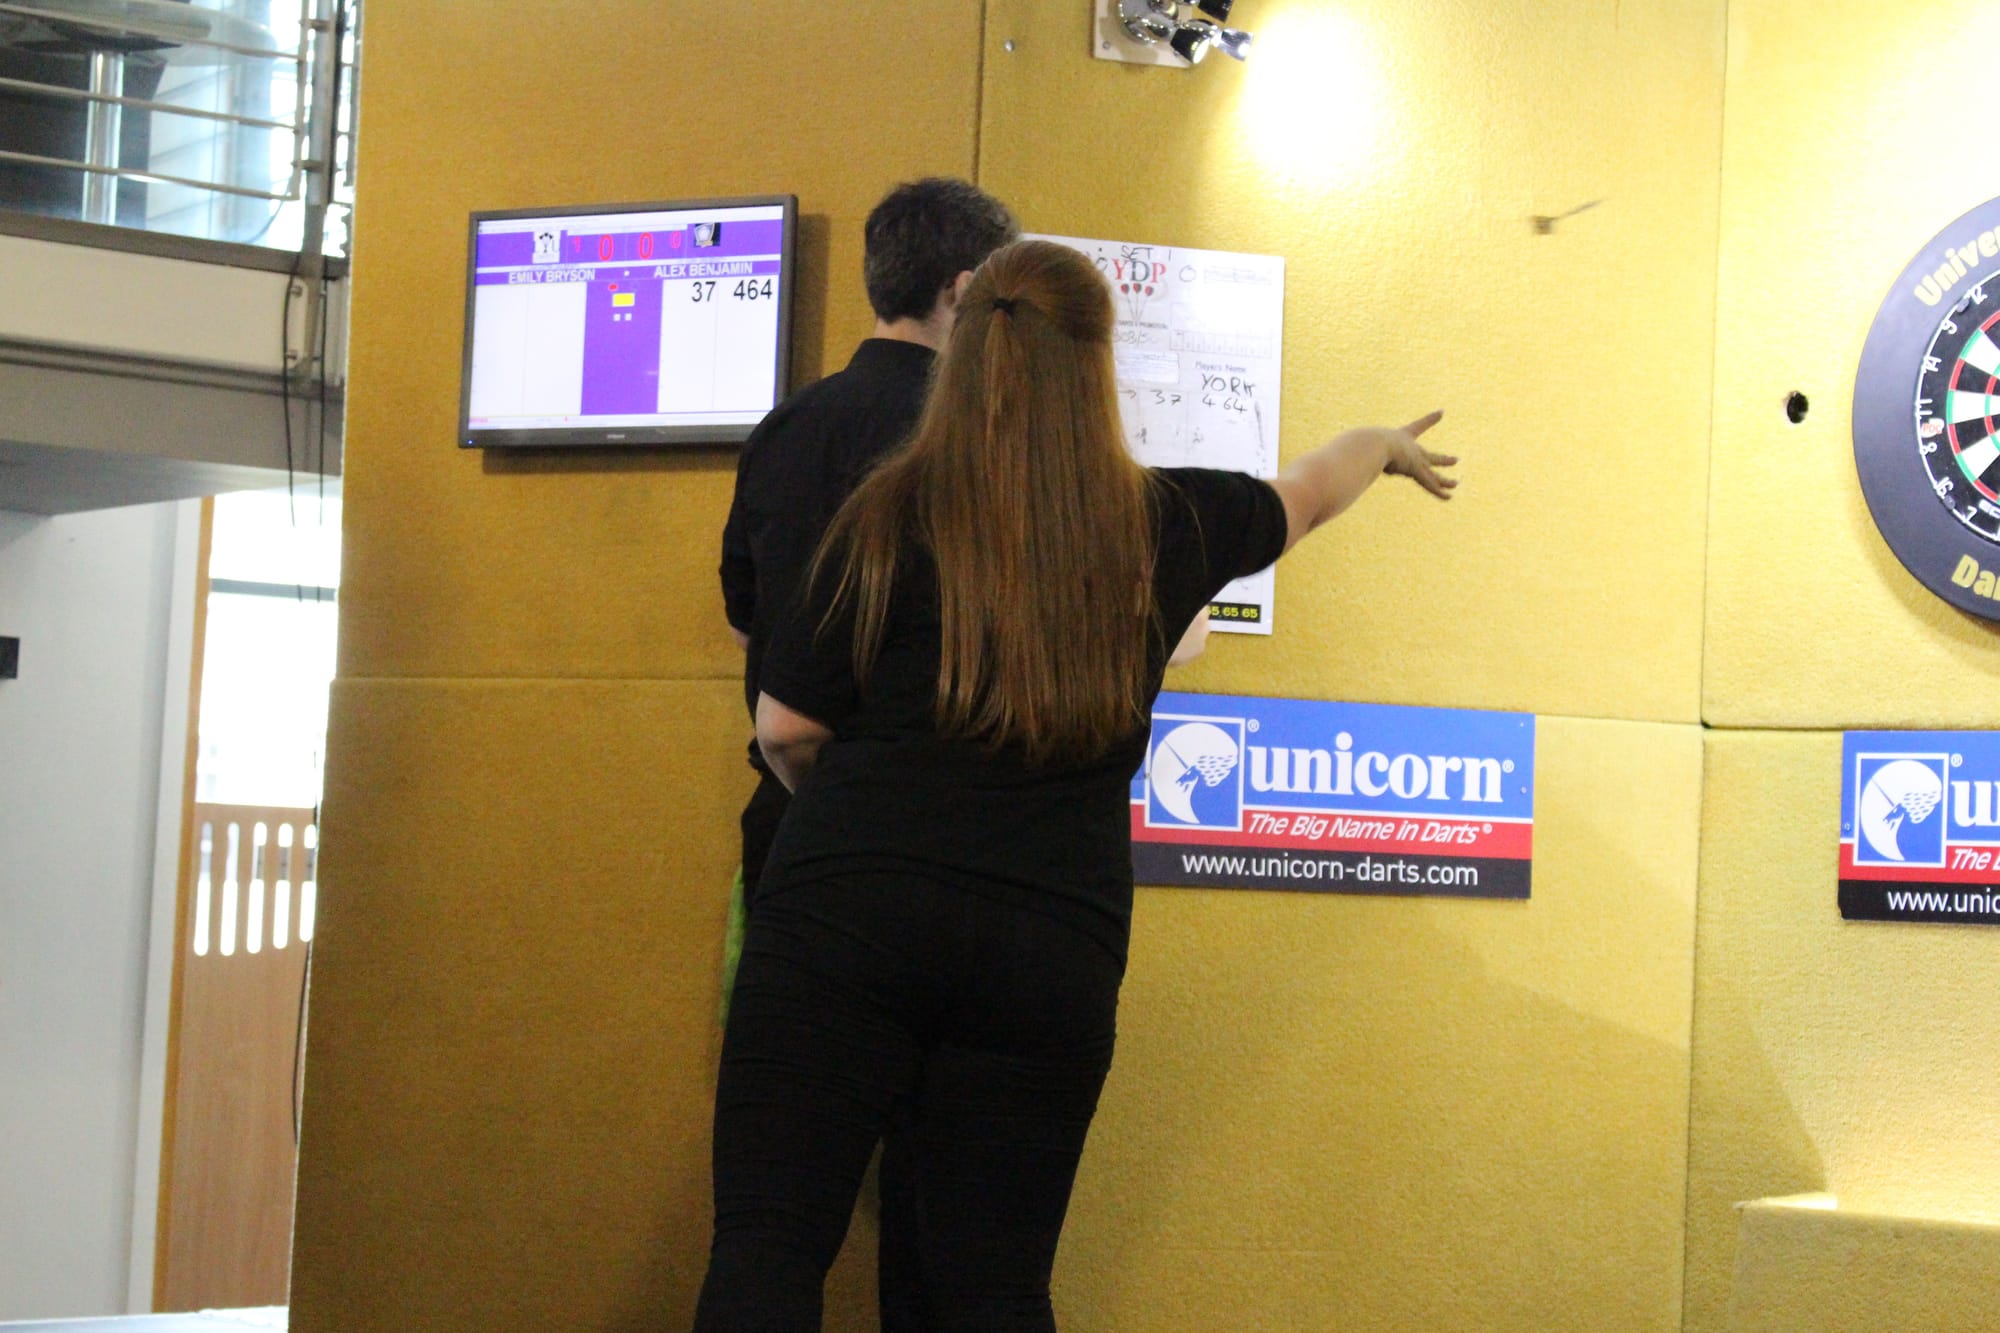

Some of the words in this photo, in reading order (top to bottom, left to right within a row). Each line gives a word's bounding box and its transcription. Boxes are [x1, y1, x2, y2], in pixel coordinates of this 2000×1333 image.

[599, 234, 614, 261] 0
[639, 231, 654, 260] 0
[1121, 244, 1154, 262] SET
[508, 271, 544, 284] EMILY
[545, 268, 596, 283] BRYSON
[653, 264, 687, 279] ALEX
[689, 261, 753, 277] BENJAMIN
[1112, 257, 1167, 284] YDP
[691, 280, 717, 303] 37
[733, 278, 773, 301] 464
[1223, 606, 1239, 617] 65
[1242, 608, 1258, 619] 65
[1247, 731, 1504, 803] unicorn
[1248, 812, 1289, 836] The
[1290, 815, 1328, 840] Big
[1329, 817, 1396, 841] Name
[1396, 820, 1419, 841] in
[1419, 822, 1480, 844] Darts
[1181, 851, 1479, 886] www.unicorn-darts.com
[1951, 848, 1992, 871] The
